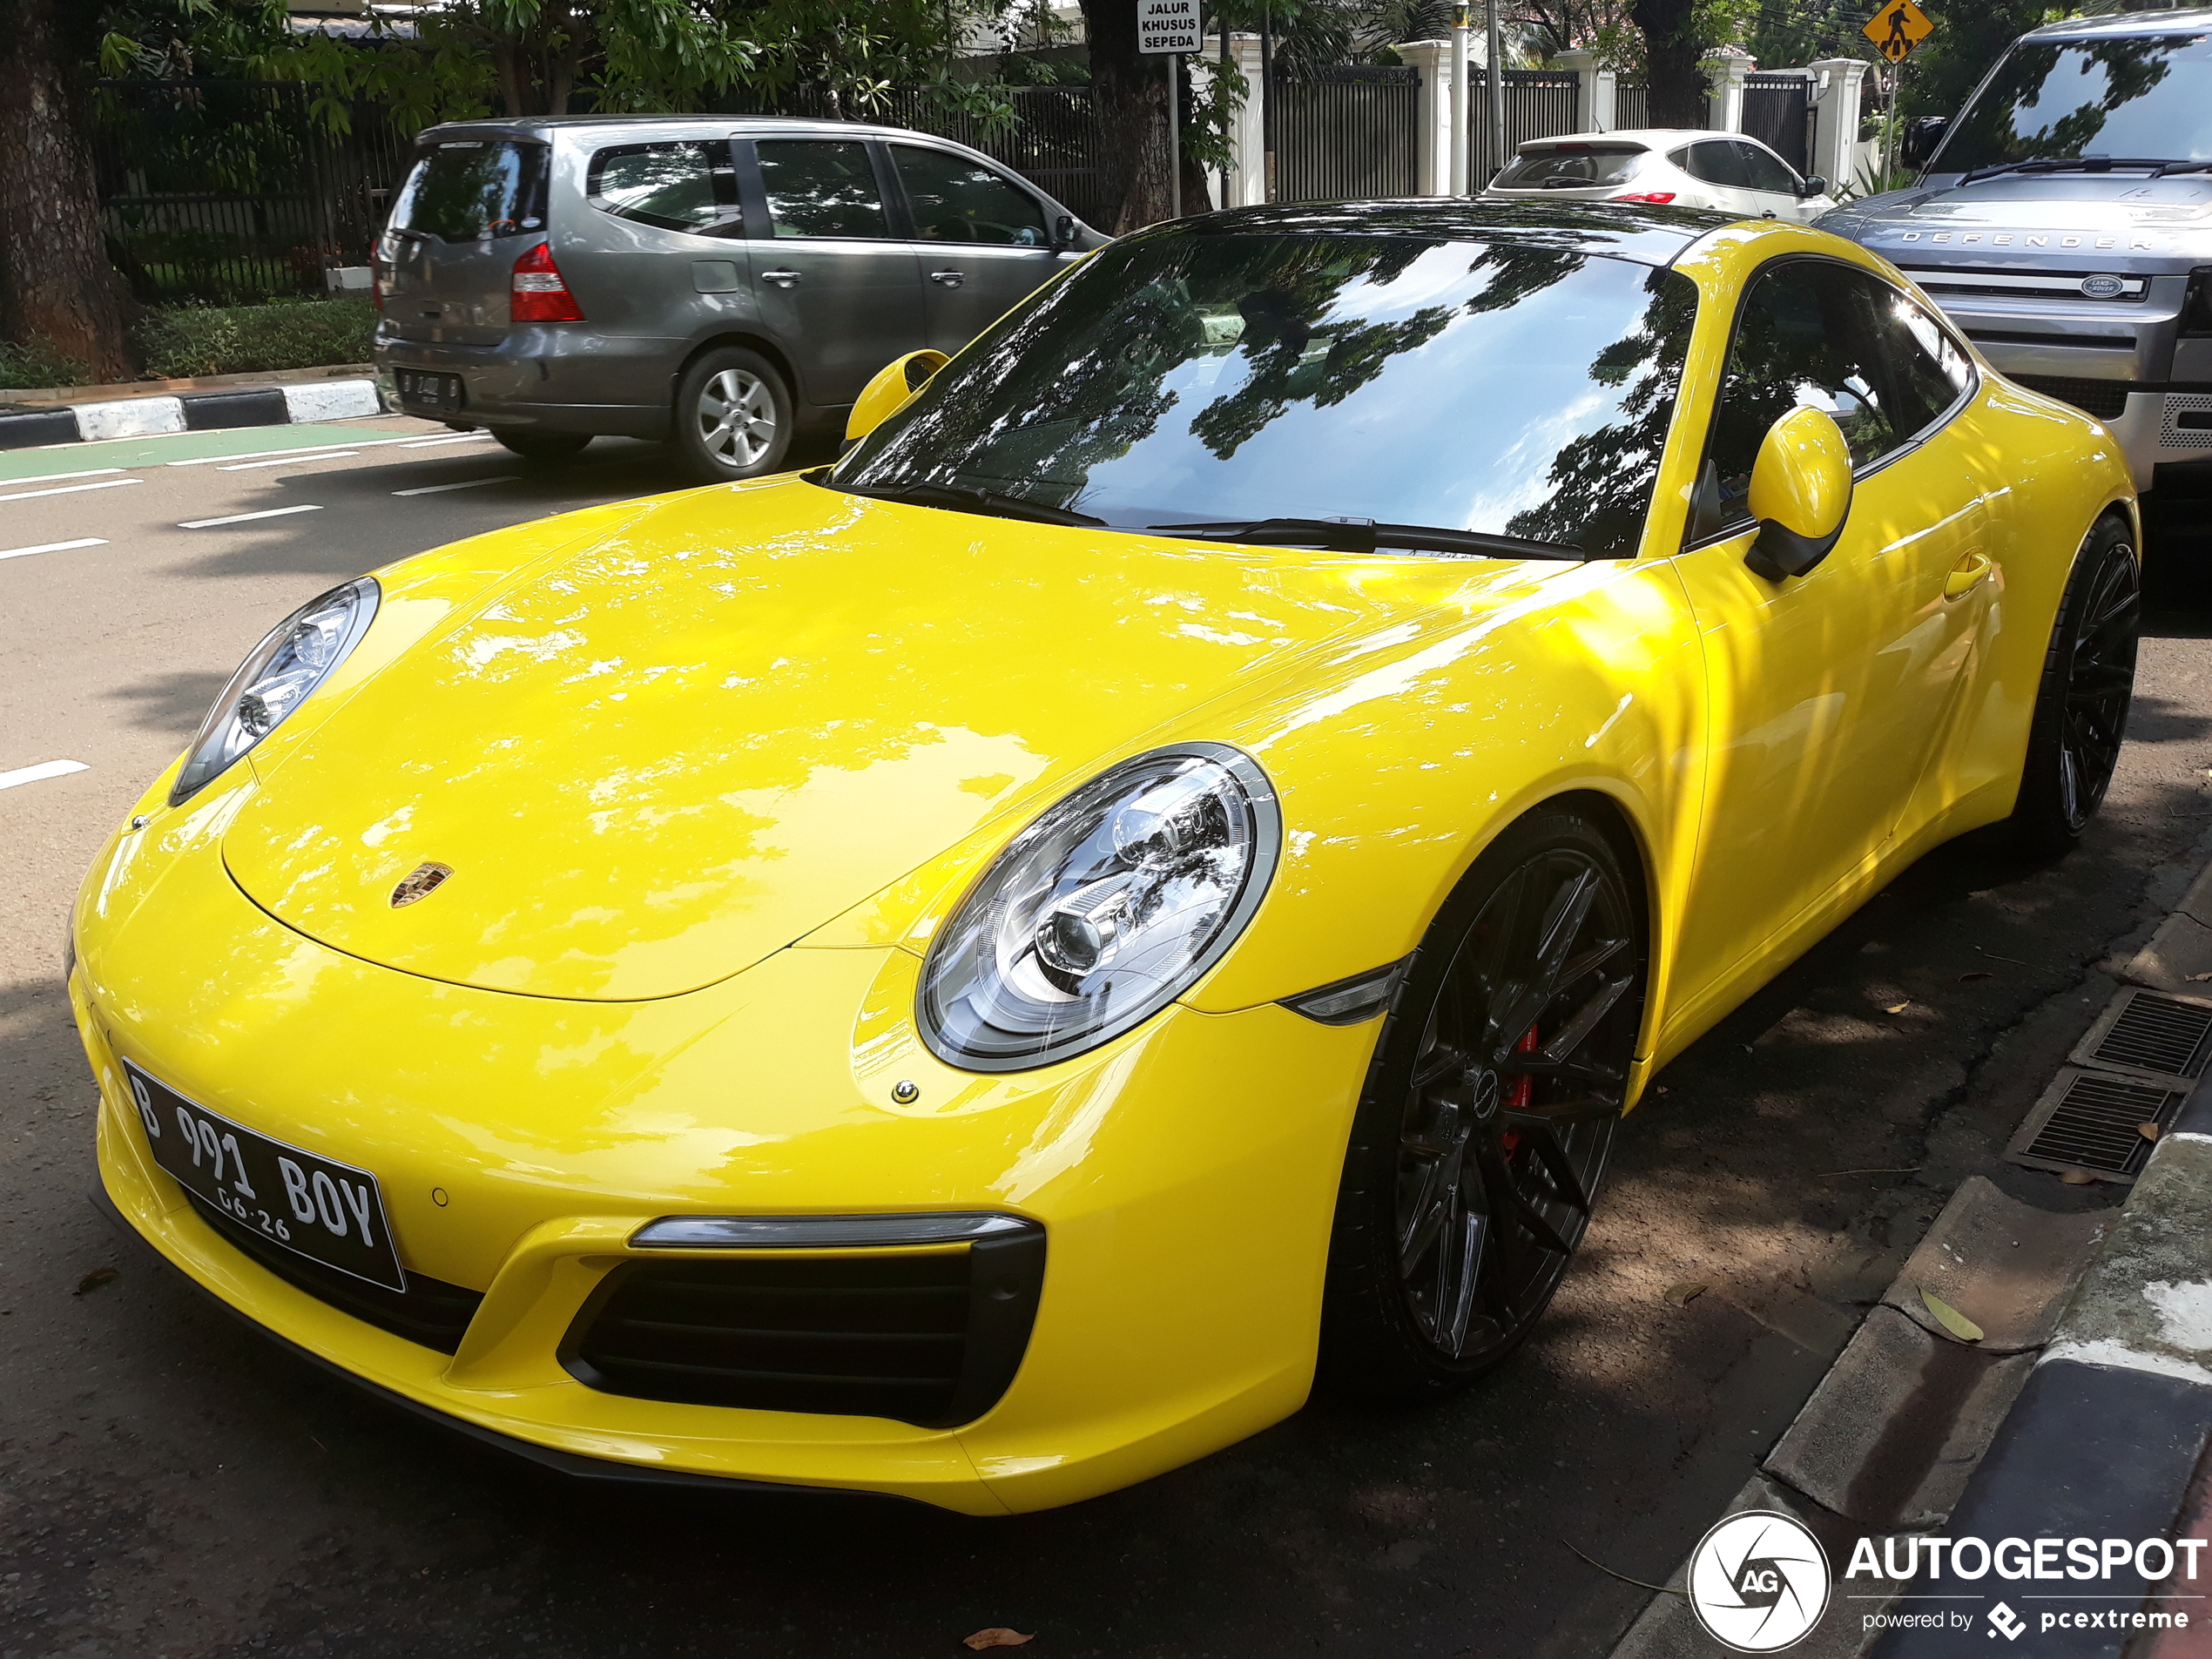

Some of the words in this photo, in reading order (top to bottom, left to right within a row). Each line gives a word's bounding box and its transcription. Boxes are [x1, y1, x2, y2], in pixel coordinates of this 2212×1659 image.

[1148, 2, 1190, 15] JALUR
[1142, 18, 1196, 32] KHUSUS
[1144, 35, 1194, 48] SEPEDA
[1901, 232, 2152, 250] DEFENDER
[131, 1074, 161, 1139] B
[176, 1106, 256, 1200] 991
[277, 1156, 374, 1248] BOY
